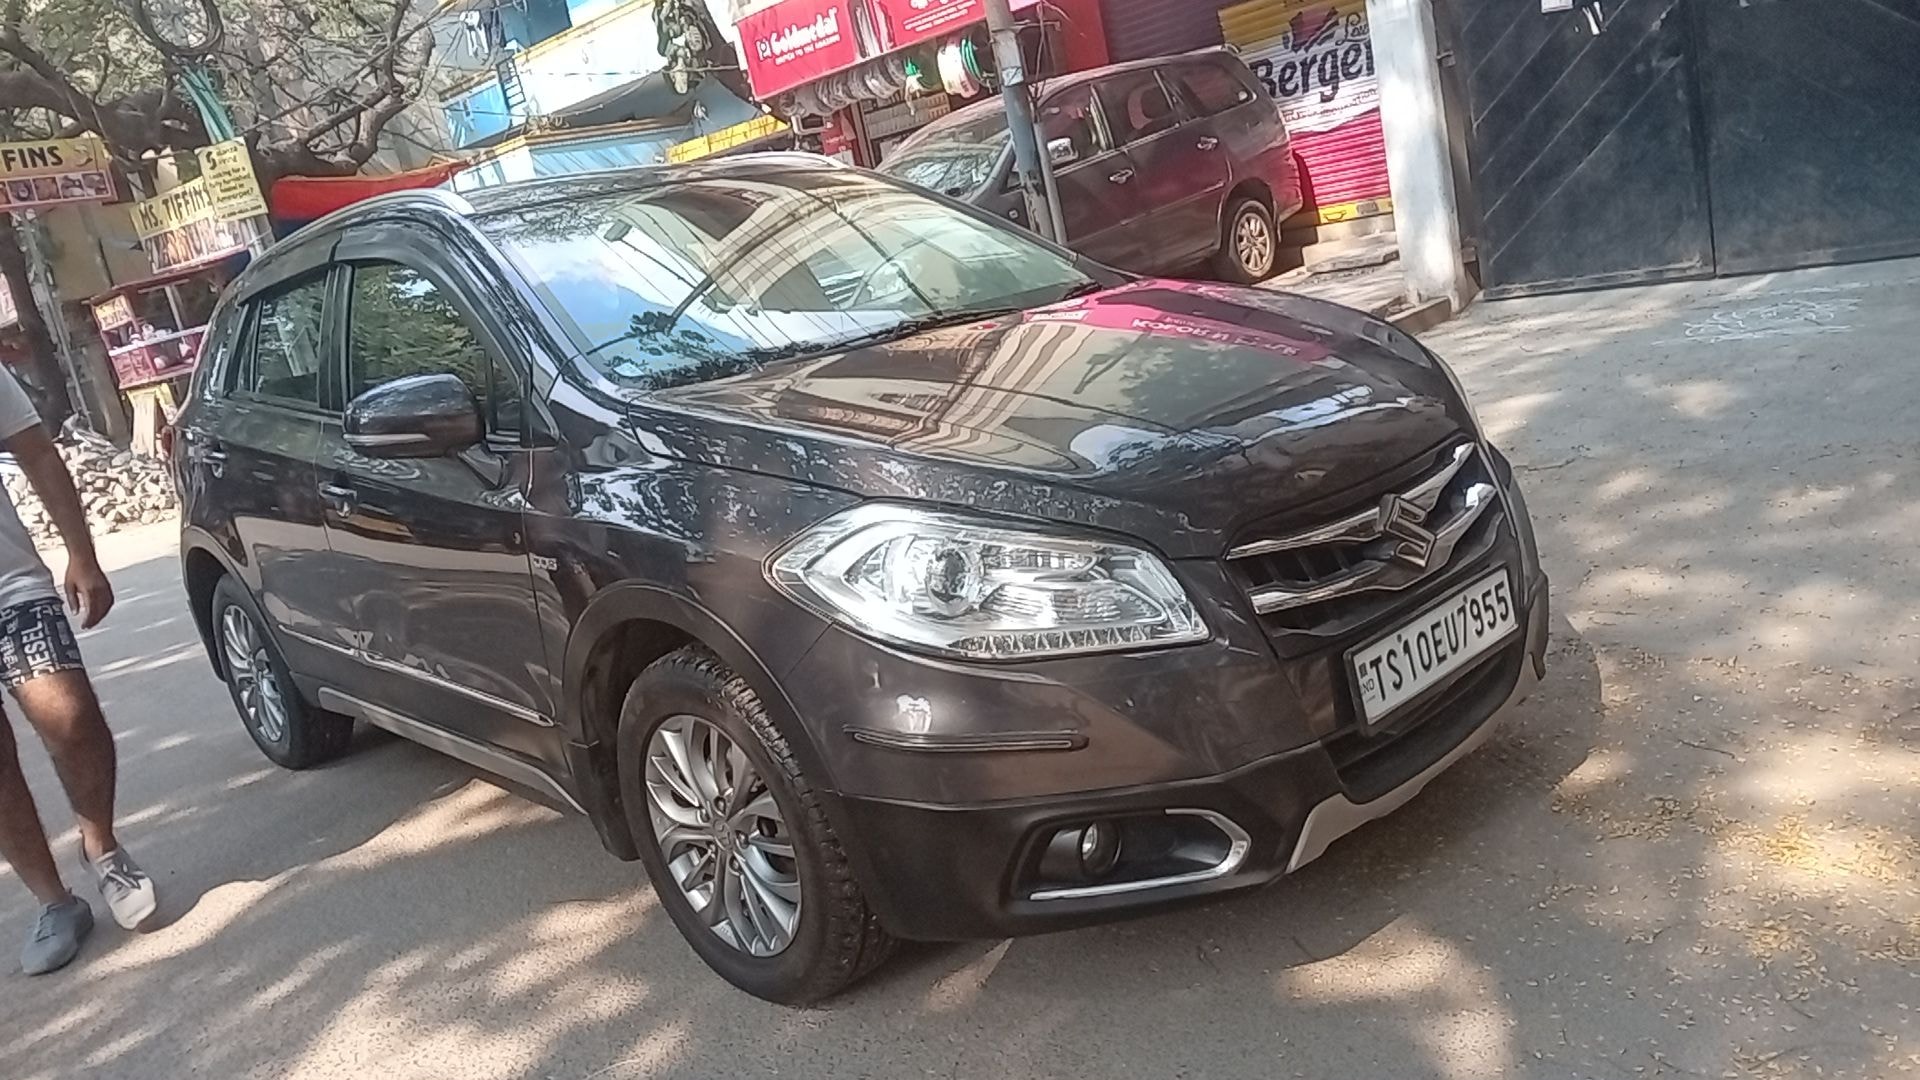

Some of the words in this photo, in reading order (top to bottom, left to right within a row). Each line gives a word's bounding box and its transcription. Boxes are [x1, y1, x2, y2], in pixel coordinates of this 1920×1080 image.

[770, 6, 838, 56] Goldmedal
[1, 146, 63, 172] FINS
[139, 202, 163, 231] MS.
[162, 181, 213, 221] TIFFINS
[1369, 580, 1510, 702] TS10EU7955
